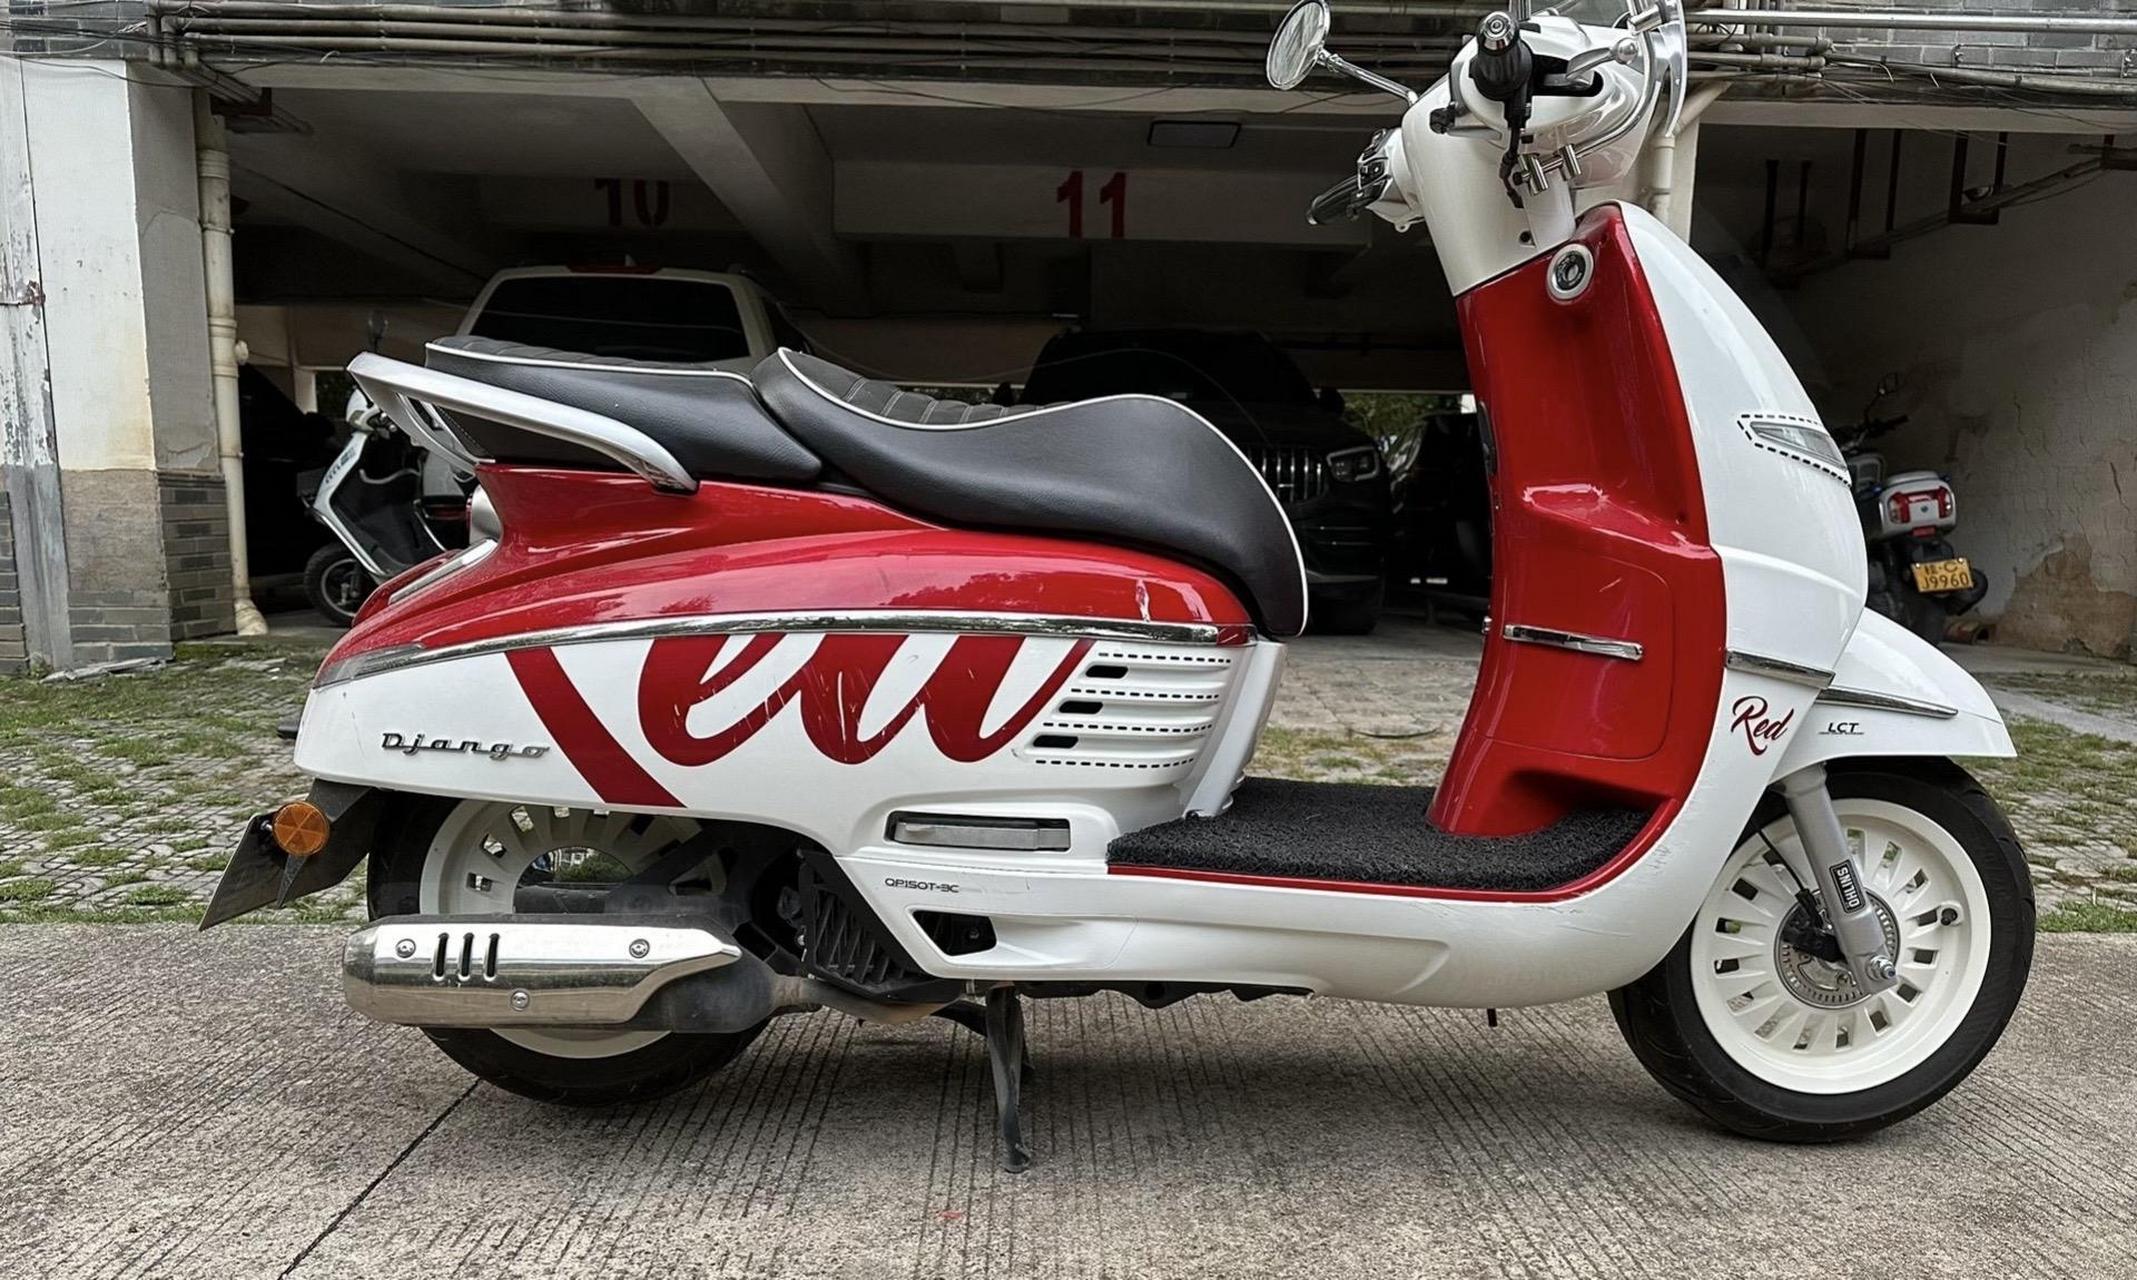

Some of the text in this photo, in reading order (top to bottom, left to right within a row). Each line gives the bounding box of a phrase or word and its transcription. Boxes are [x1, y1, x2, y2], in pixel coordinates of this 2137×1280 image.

[1057, 171, 1126, 239] 11
[1922, 572, 1969, 589] J9960
[1730, 695, 1795, 756] Red
[1827, 722, 1860, 733] LCT
[381, 732, 550, 761] Django
